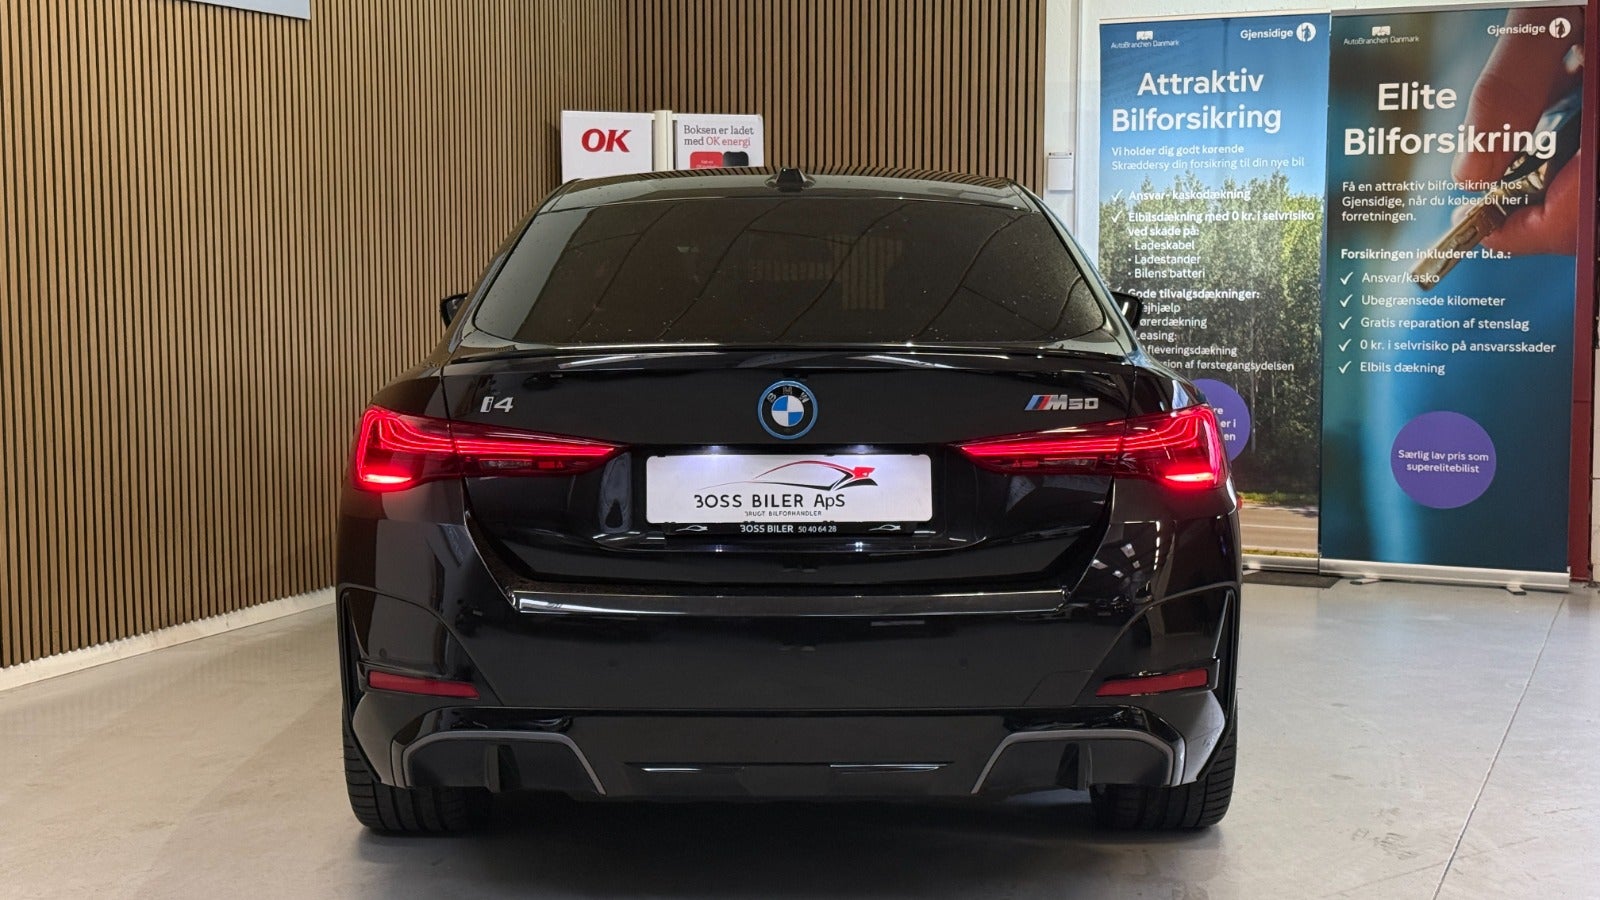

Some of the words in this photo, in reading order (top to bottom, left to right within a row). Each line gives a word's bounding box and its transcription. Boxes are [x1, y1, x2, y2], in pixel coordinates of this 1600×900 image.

[1240, 29, 1293, 40] Gjensidige
[1487, 24, 1546, 36] Gjensidige
[1343, 37, 1388, 45] AutoBranchen
[1390, 36, 1420, 44] Danmark
[1137, 67, 1264, 96] Attraktiv
[1378, 81, 1457, 111] Elite
[1112, 104, 1281, 134] Bilforsikring
[684, 125, 717, 135] Boksen
[719, 126, 728, 135] er
[730, 126, 754, 135] ladet
[581, 128, 632, 152] OK
[684, 136, 704, 146] med
[706, 137, 720, 146] OK
[722, 137, 750, 148] energi
[1344, 123, 1556, 160] Bilforsikring
[1112, 147, 1123, 156] Vi
[1124, 146, 1156, 156] holder
[1158, 146, 1174, 157] dig
[1176, 145, 1200, 156] godt
[1202, 144, 1244, 155] kørende
[1112, 161, 1168, 172] Skræddersy
[1172, 160, 1188, 170] din
[1190, 158, 1237, 170] forsikring
[1240, 158, 1250, 168] til
[1252, 158, 1267, 168] din
[1270, 159, 1289, 170] nye
[1291, 156, 1304, 167] bil
[1342, 181, 1355, 192] Få
[1358, 183, 1372, 192] en
[1375, 181, 1425, 192] attraktiv
[1428, 180, 1497, 192] bilforsikring
[1500, 180, 1522, 190] hos
[1129, 191, 1170, 200] Ansvar-
[1172, 190, 1250, 202] kaskodækning
[1342, 196, 1405, 208] Gjensidige,
[1408, 195, 1427, 206] når
[1430, 196, 1444, 206] du
[1447, 195, 1482, 206] køber
[1484, 194, 1498, 206] bil
[1501, 194, 1522, 205] her
[1524, 195, 1528, 205] i
[1128, 212, 1202, 224] Elbilsdækning
[1204, 212, 1228, 222] med
[1232, 212, 1239, 221] 0
[1241, 211, 1255, 220] kr.
[1257, 211, 1260, 220] i
[1262, 210, 1314, 221] selvrisiko
[1342, 210, 1416, 224] forretningen.
[1128, 226, 1148, 236] ved
[1150, 226, 1181, 236] skade
[1183, 226, 1200, 238] på:
[1134, 240, 1195, 250] Ladeskabel
[1134, 254, 1201, 264] Ladestander
[1341, 248, 1414, 262] Forsikringen
[1416, 248, 1478, 260] inkluderer
[1481, 249, 1512, 260] bl.a.:
[1134, 268, 1167, 278] Bilens
[1170, 268, 1206, 278] batteri
[1362, 272, 1440, 284] Ansvar/kasko
[1159, 288, 1260, 301] tilvalgsdækninger:
[1361, 295, 1444, 308] Ubegrænsede
[1447, 295, 1506, 306] kilometer
[1142, 302, 1181, 315] ejhjælp
[1140, 316, 1208, 329] ørerdækning
[1360, 317, 1396, 328] Gratis
[1398, 318, 1460, 330] reparation
[1462, 318, 1476, 329] af
[1478, 318, 1530, 332] stenslag
[1360, 340, 1368, 350] 0
[1370, 340, 1385, 350] kr.
[1388, 340, 1392, 350] i
[1394, 340, 1449, 352] selvrisiko
[1452, 340, 1467, 354] på
[1470, 342, 1556, 353] ansvarsskader
[1184, 360, 1194, 370] af
[1196, 359, 1294, 373] førstegangsydelsen
[1360, 362, 1392, 372] Elbils
[1394, 362, 1446, 376] dækning
[766, 386, 810, 403] BMW
[480, 396, 514, 412] i4
[1034, 394, 1099, 410] M50
[1398, 450, 1430, 462] Særlig
[1432, 450, 1447, 460] lav
[1449, 451, 1466, 463] pris
[1468, 452, 1489, 462] som
[1406, 462, 1480, 474] superelitebilist
[752, 494, 804, 508] BILER
[814, 494, 846, 510] ApS
[766, 524, 794, 533] BILER
